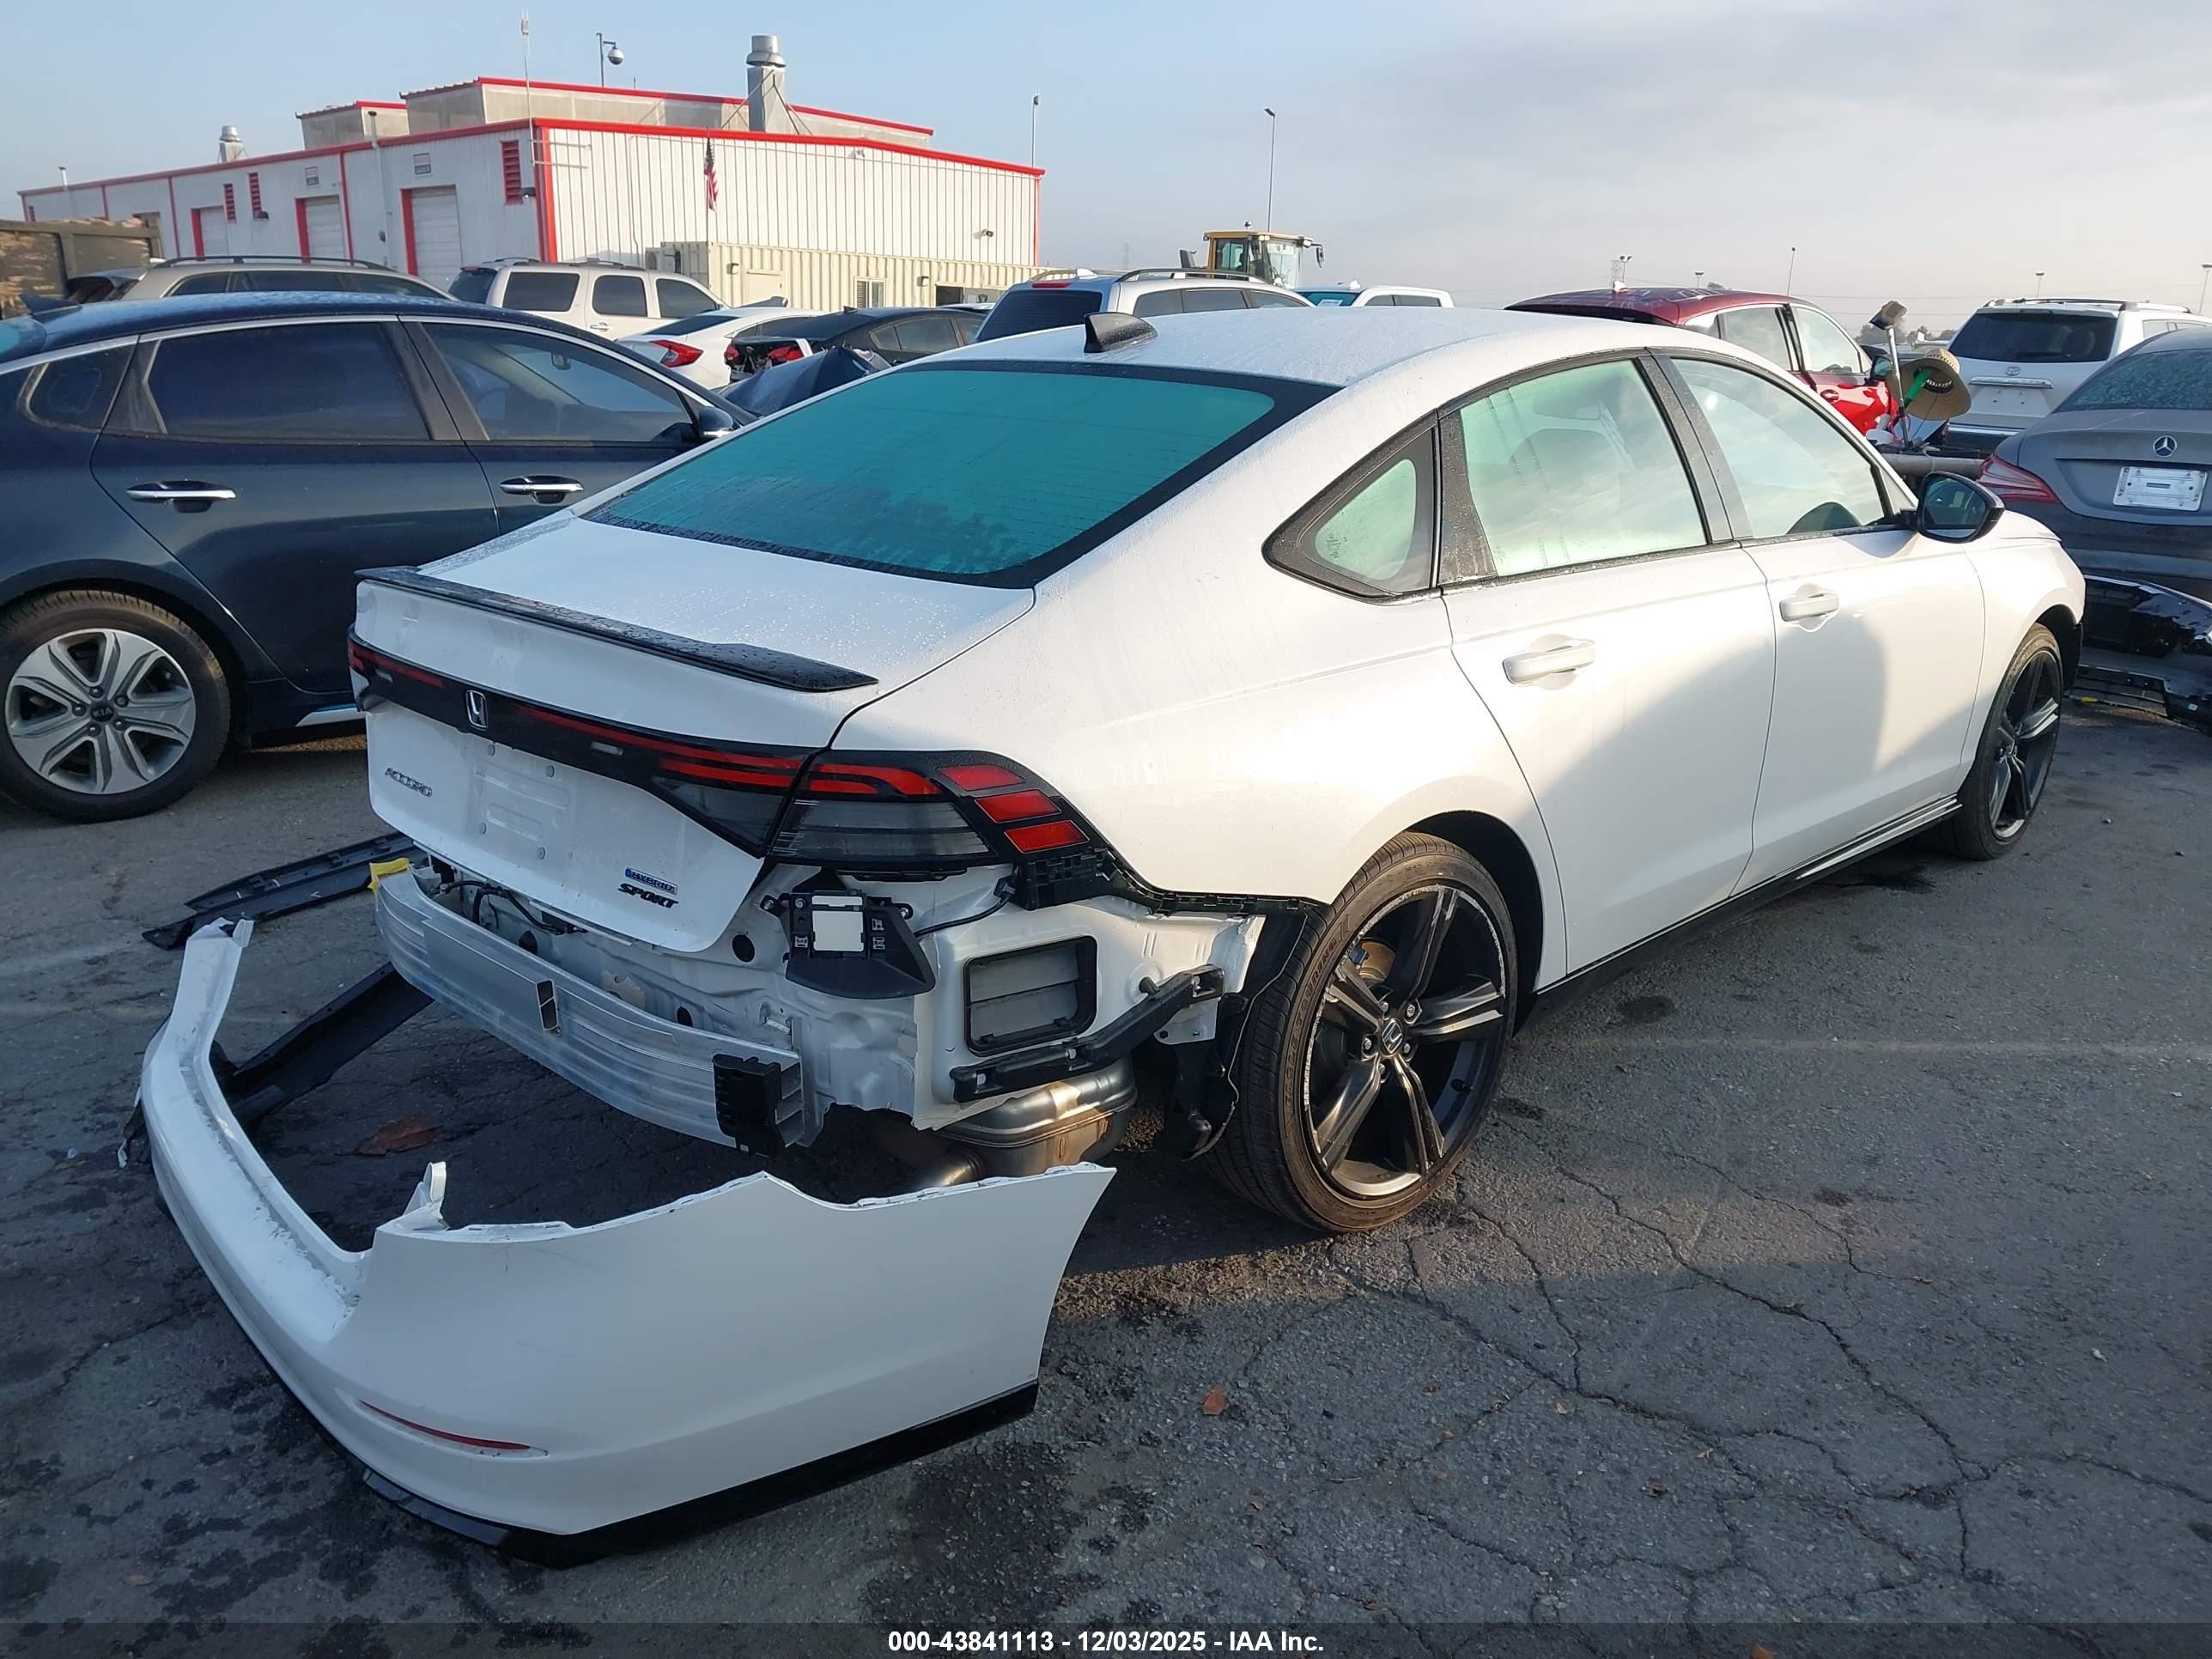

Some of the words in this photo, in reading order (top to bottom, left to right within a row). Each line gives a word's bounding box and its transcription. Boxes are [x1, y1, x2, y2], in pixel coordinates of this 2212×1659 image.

[93, 707, 112, 718] KIA
[384, 767, 433, 797] ACCORD
[631, 870, 674, 893] HYBRID
[617, 882, 679, 908] SPORT
[1296, 937, 1338, 1027] TOURING
